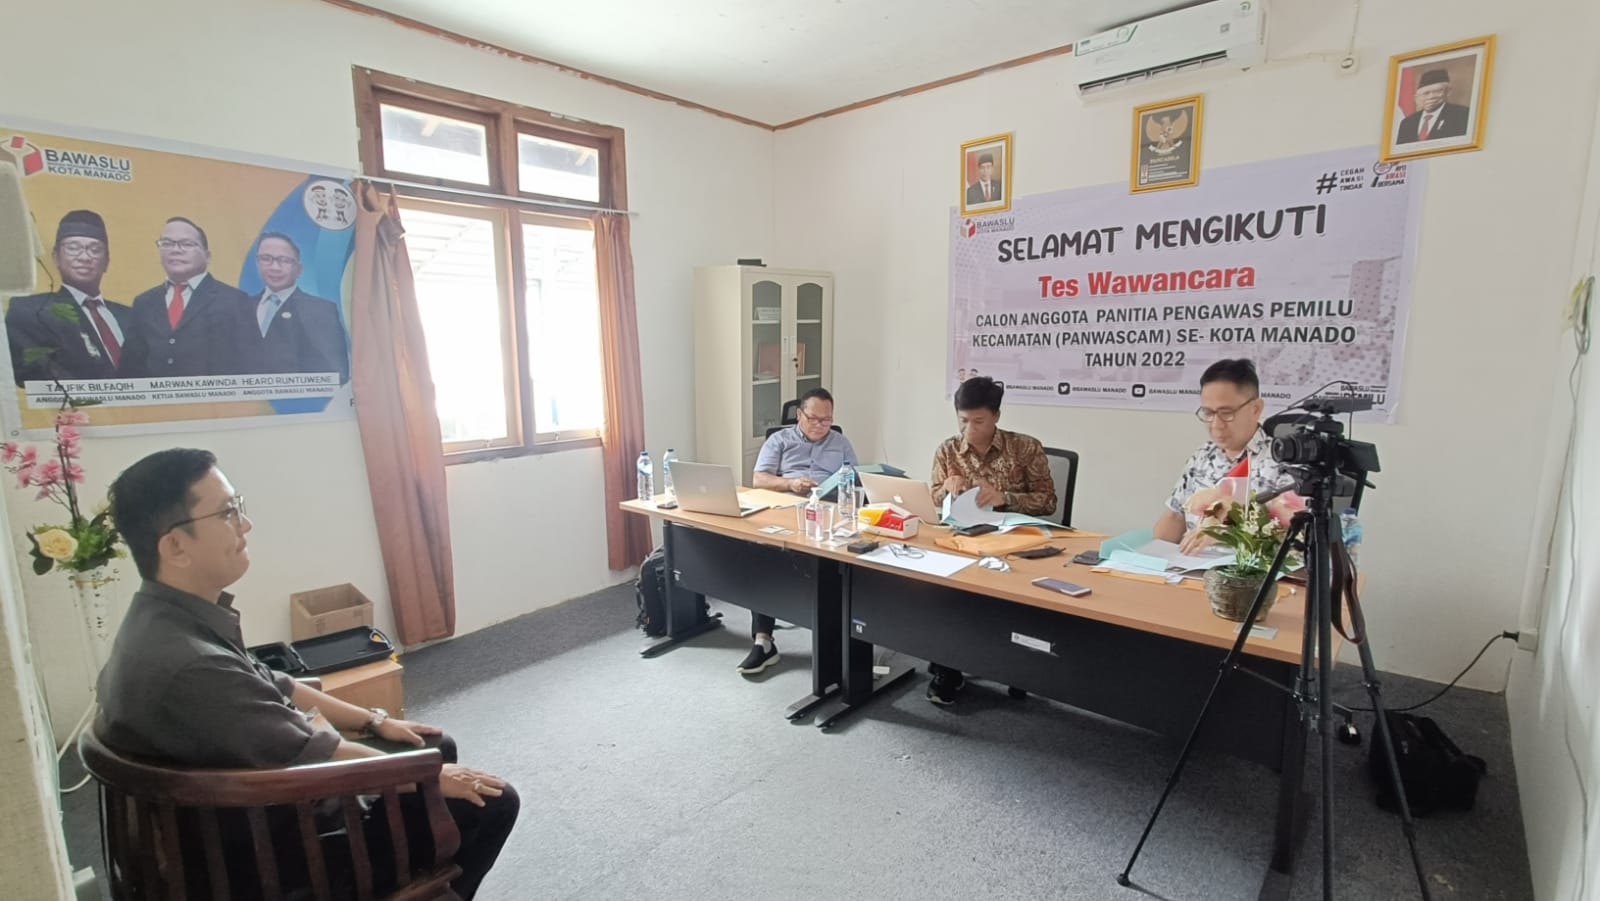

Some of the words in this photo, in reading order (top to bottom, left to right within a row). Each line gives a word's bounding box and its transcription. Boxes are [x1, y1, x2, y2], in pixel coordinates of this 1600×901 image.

[45, 149, 130, 171] BAWASLU
[48, 165, 81, 176] KOTA
[84, 170, 131, 182] MANADO
[976, 217, 1015, 228] BAWASLU
[997, 226, 1123, 263] SELAMAT
[1135, 203, 1327, 250] MENGIKUTI
[1038, 275, 1079, 298] Tes
[1087, 265, 1256, 296] Wawancara
[975, 313, 1018, 327] CALON
[1021, 310, 1088, 326] ANGGOTA
[1096, 307, 1157, 323] PANITIA
[1163, 302, 1264, 321] PENGAWAS
[1269, 299, 1353, 318] PEMILU
[972, 333, 1051, 347] KECAMATAN
[1055, 329, 1171, 348] (PANWASCAM)
[1176, 329, 1205, 344] SE-
[1209, 327, 1256, 343] KOTA
[1260, 326, 1356, 343] MANADO
[1084, 352, 1137, 367] TAHUN
[1141, 351, 1185, 367] 2022
[88, 383, 134, 393] BILFAQIH
[150, 380, 194, 390] MARWAN
[195, 379, 237, 388] KAWINDA
[242, 377, 274, 386] HEARD
[276, 375, 331, 385] RUNTUWENE
[152, 392, 174, 400] KETUA
[175, 391, 207, 399] BAWASLU
[1261, 392, 1292, 400] MANADO
